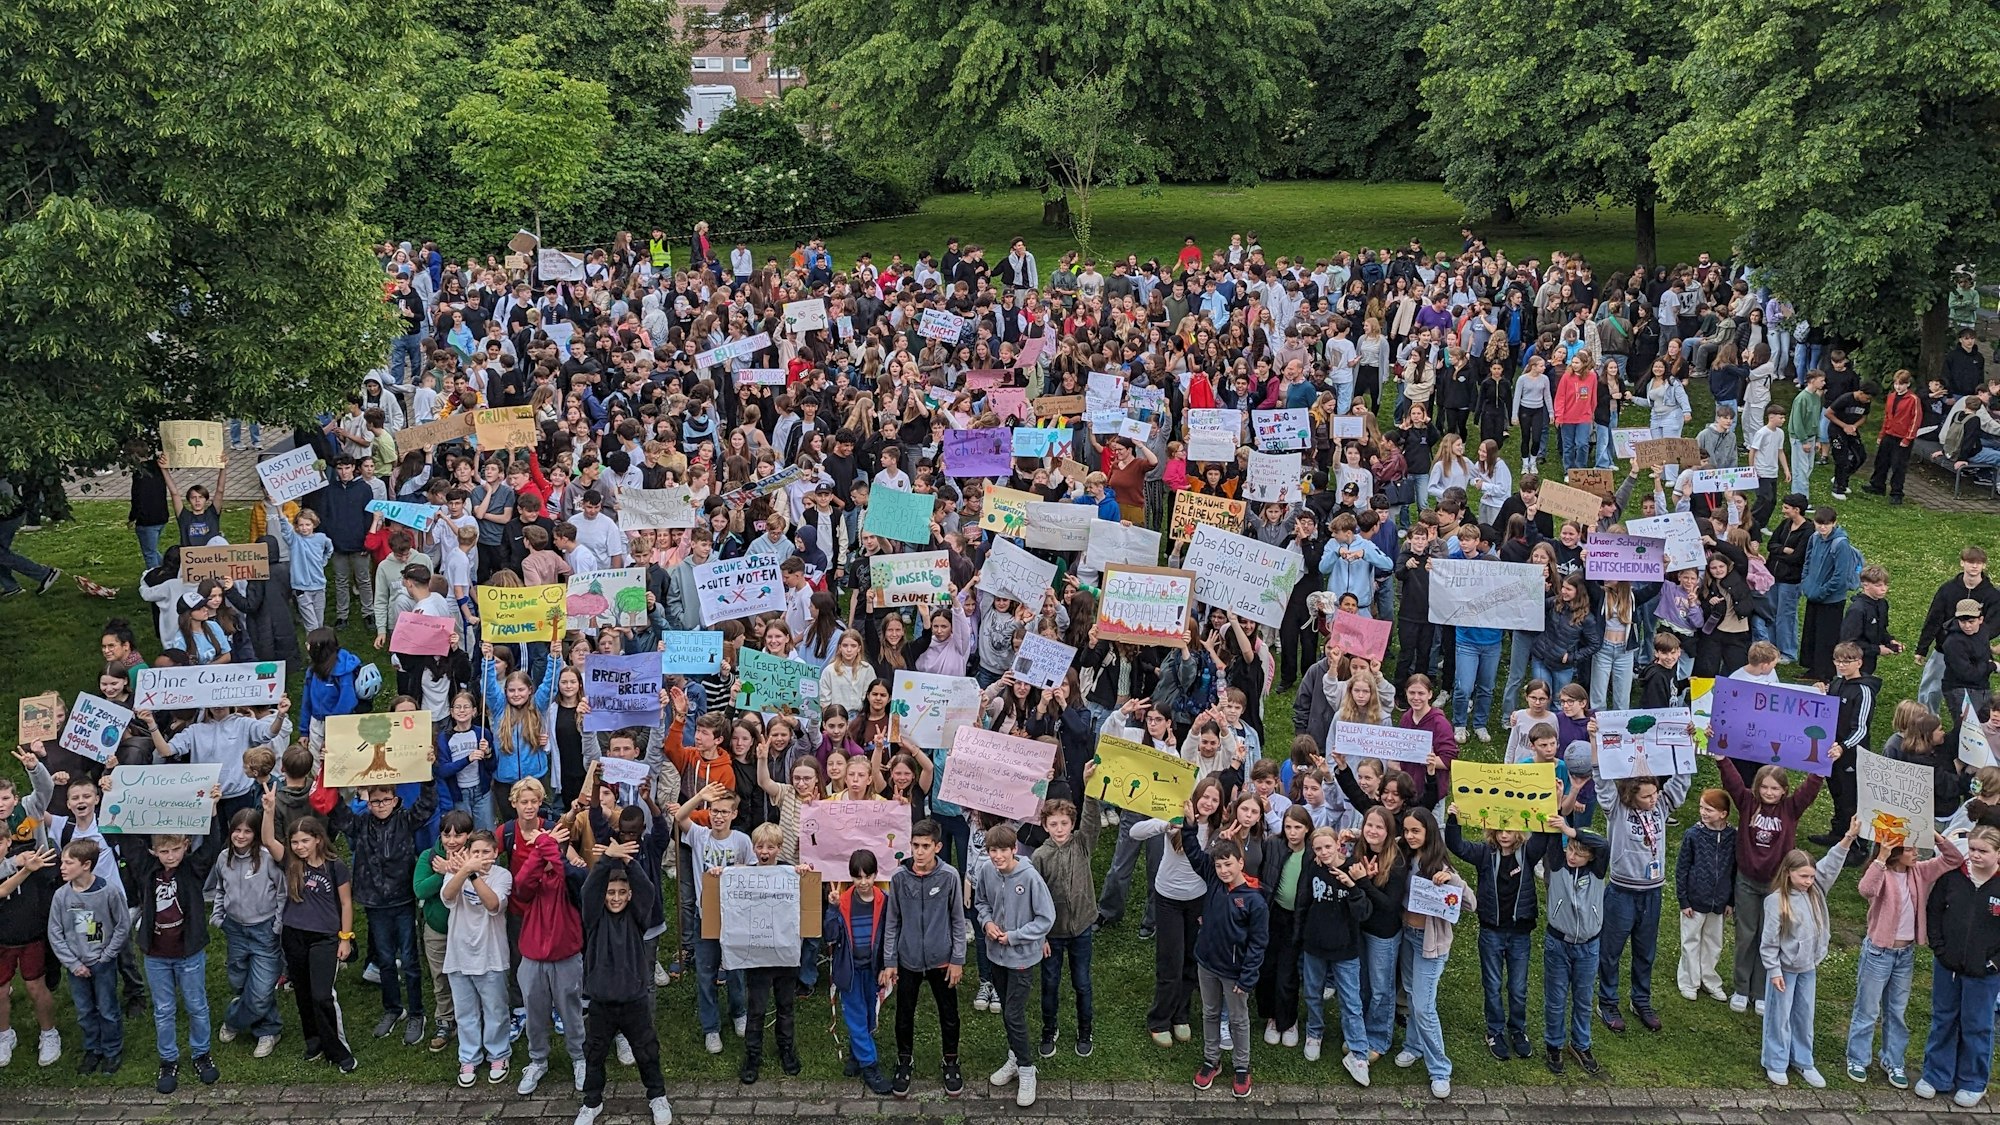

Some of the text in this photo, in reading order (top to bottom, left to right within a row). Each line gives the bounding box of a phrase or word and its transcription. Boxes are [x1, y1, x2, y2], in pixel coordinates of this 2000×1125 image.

[931, 325, 957, 336] NICHT
[1260, 424, 1282, 435] BUNT
[260, 450, 312, 477] LASST DIE
[269, 465, 314, 490] BÄUME
[280, 479, 318, 501] LEBEN
[1178, 493, 1195, 505] DIE
[1175, 504, 1215, 521] BLEIBEN
[1589, 537, 1615, 546] Unser
[185, 550, 252, 564] Save the TREE
[1195, 530, 1287, 571] Das ASG ist bunt
[934, 558, 949, 569] ASG
[1190, 551, 1270, 589] da gehört auch
[1589, 561, 1660, 574] ENTSCHEIDUNG
[187, 567, 207, 582] For
[228, 564, 254, 580] TEEN
[707, 568, 778, 590] GUTE NOTEN
[895, 569, 934, 586] UNSERE
[488, 589, 524, 601] Ohne
[1193, 577, 1266, 617] GRÜN dazu
[664, 631, 722, 646] RETTET
[669, 654, 706, 663] SCHULHOF
[743, 654, 778, 672] LIEBER
[142, 671, 188, 690] Ohne
[592, 669, 632, 684] BREUER
[743, 671, 759, 680] ALS
[771, 674, 795, 689] NEUE
[618, 682, 657, 695] BREUER
[1755, 692, 1825, 718] DENKT
[71, 711, 100, 731] was die
[81, 699, 127, 729] Ihr zerstört
[74, 724, 92, 738] uns
[972, 731, 1001, 750] brauchen
[979, 749, 991, 760] das
[369, 772, 400, 780] Leben
[1480, 765, 1503, 774] Lasst
[1863, 752, 1932, 783] I SPEAK
[121, 770, 175, 786] Unsere
[1863, 766, 1932, 799] FOR THE
[1866, 782, 1926, 815] TREES
[726, 873, 800, 890] TREES LIFE
[727, 890, 753, 900] KEEPS
